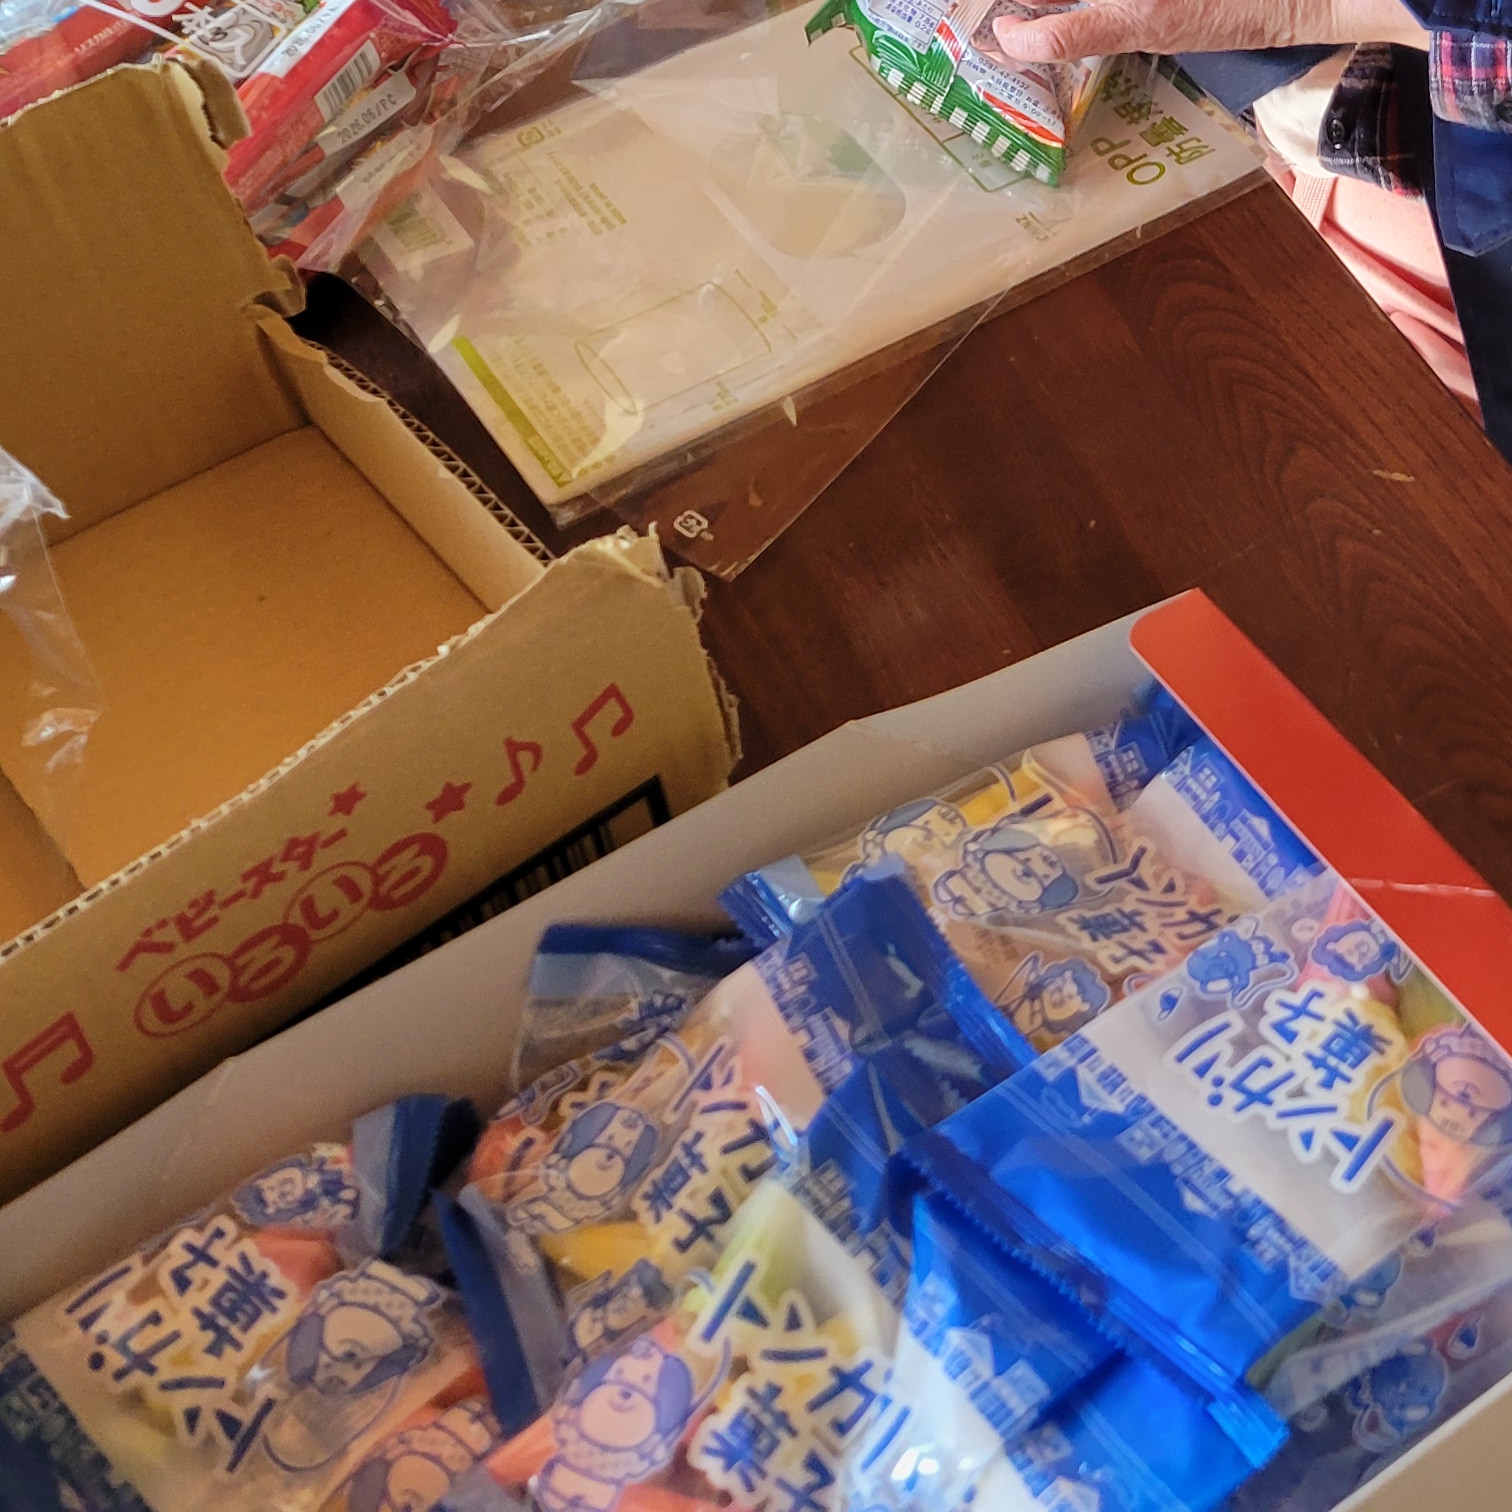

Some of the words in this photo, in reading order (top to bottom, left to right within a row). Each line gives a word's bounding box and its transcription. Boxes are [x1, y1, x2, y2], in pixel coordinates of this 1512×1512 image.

[1091, 135, 1167, 187] OPP
[115, 826, 350, 973] ベビースター
[138, 834, 448, 1036] いろいろ
[1175, 1021, 1396, 1183] トンガリ
[1272, 989, 1392, 1088] 菓子
[173, 1225, 288, 1358] 菓子
[65, 1265, 277, 1474] トンガリ
